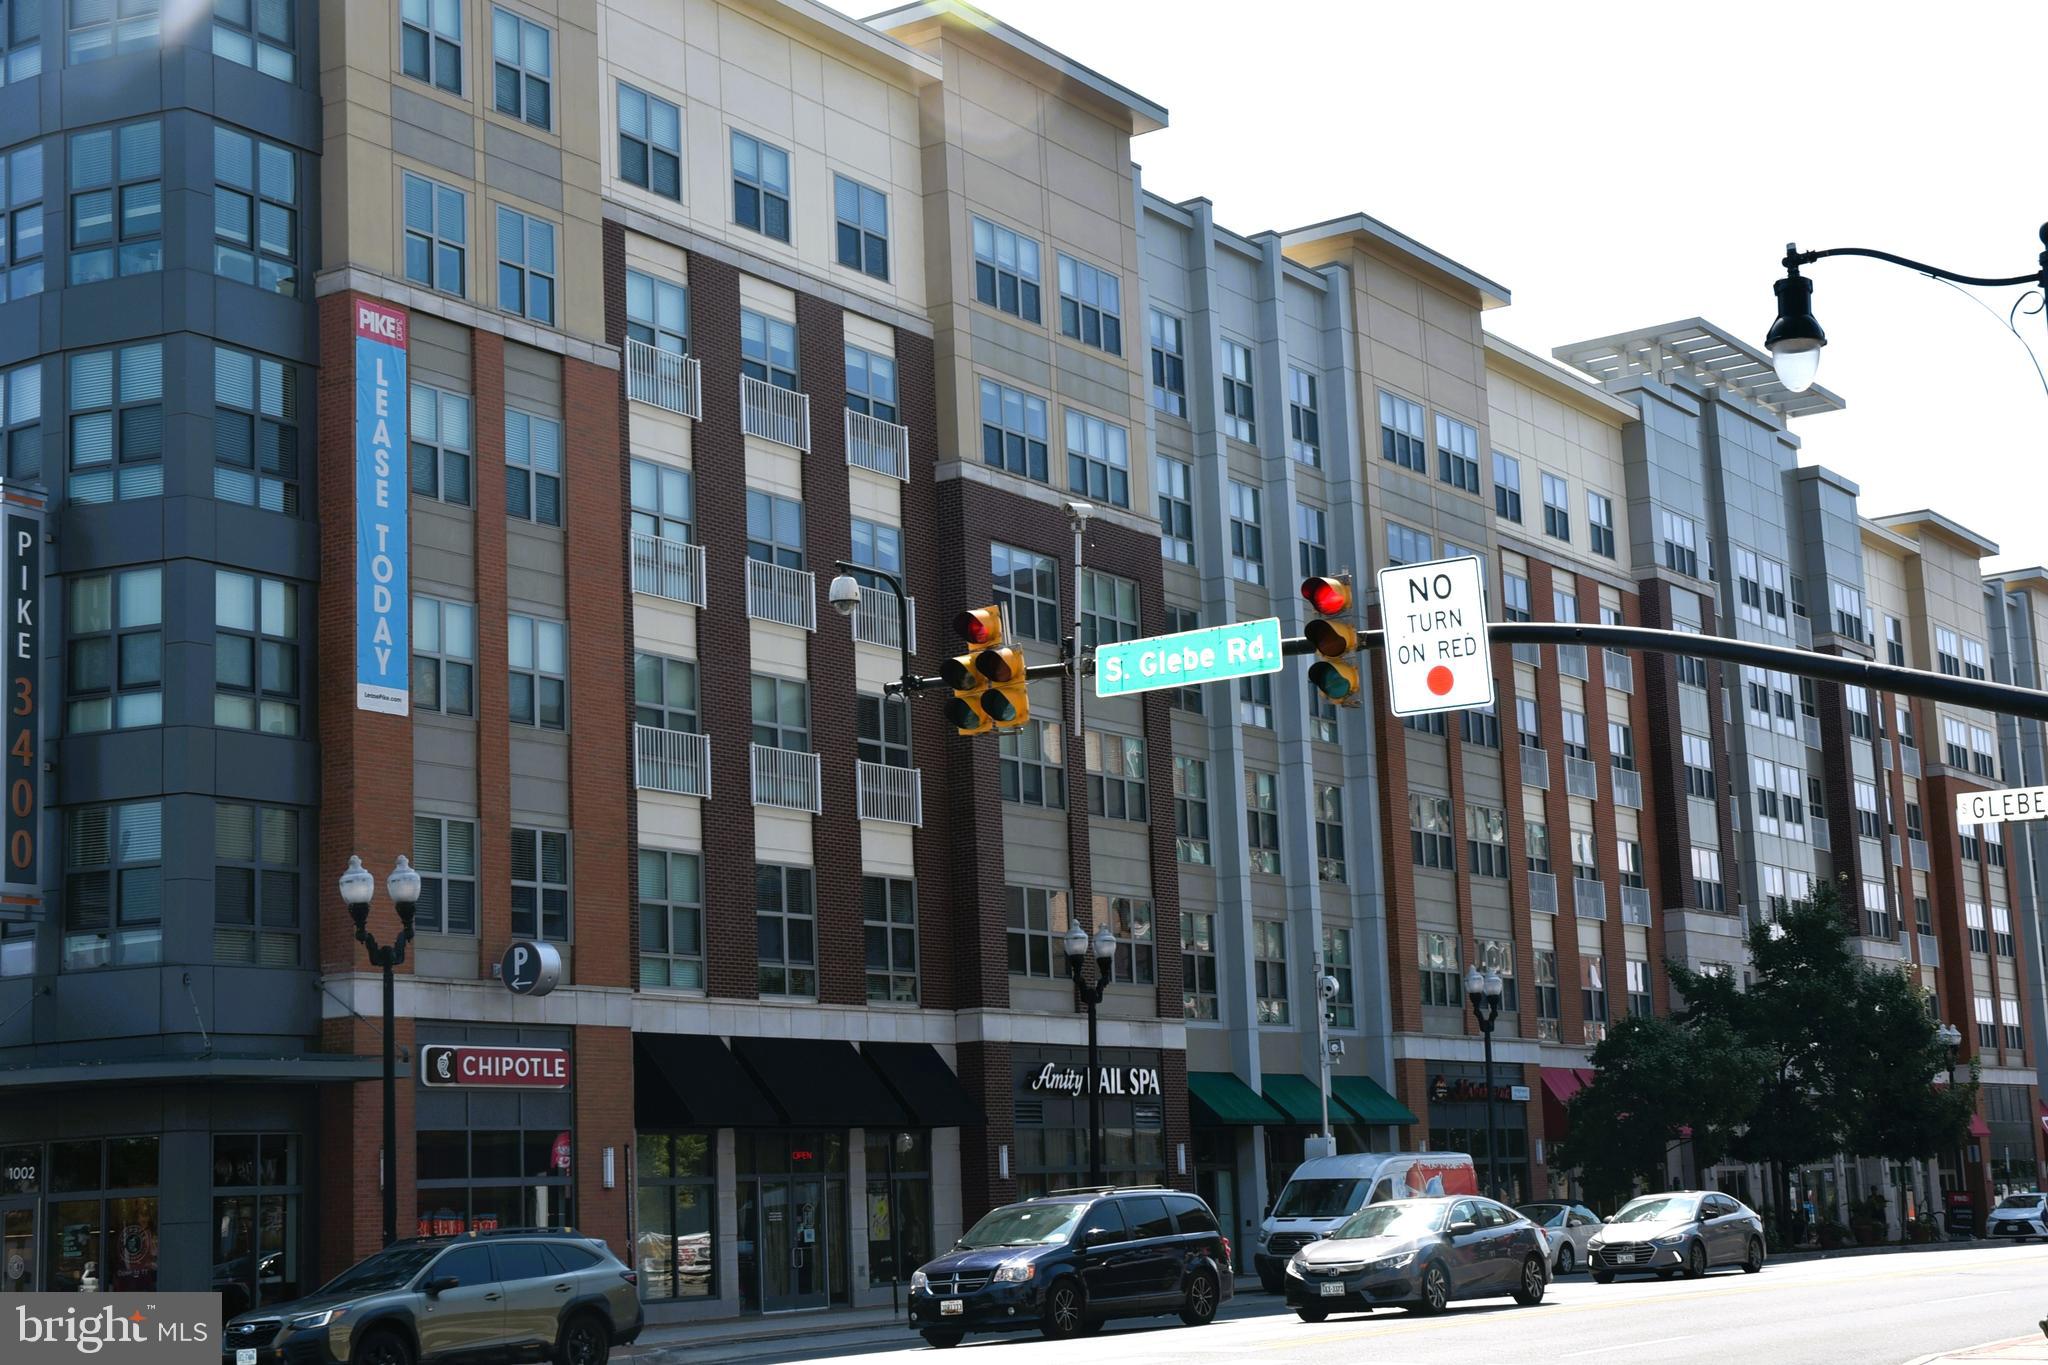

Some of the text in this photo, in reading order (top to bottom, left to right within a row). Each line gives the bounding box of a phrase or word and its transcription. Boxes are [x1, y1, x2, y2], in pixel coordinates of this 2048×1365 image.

[360, 307, 396, 339] PIKE
[371, 358, 393, 676] LEASE TODAY
[1409, 573, 1451, 603] NO
[1407, 608, 1462, 633] TURN
[1105, 634, 1273, 682] S. Glebe Rd.
[1398, 636, 1477, 665] ON RED
[11, 531, 33, 870] PIKE 3400
[1972, 791, 2046, 819] GLEBE
[514, 947, 528, 976] P
[463, 1055, 566, 1078] CHIPOTLE
[1032, 1062, 1160, 1096] Amity AIL SPA
[792, 1151, 813, 1160] OPEN
[8, 1166, 35, 1180] 1002
